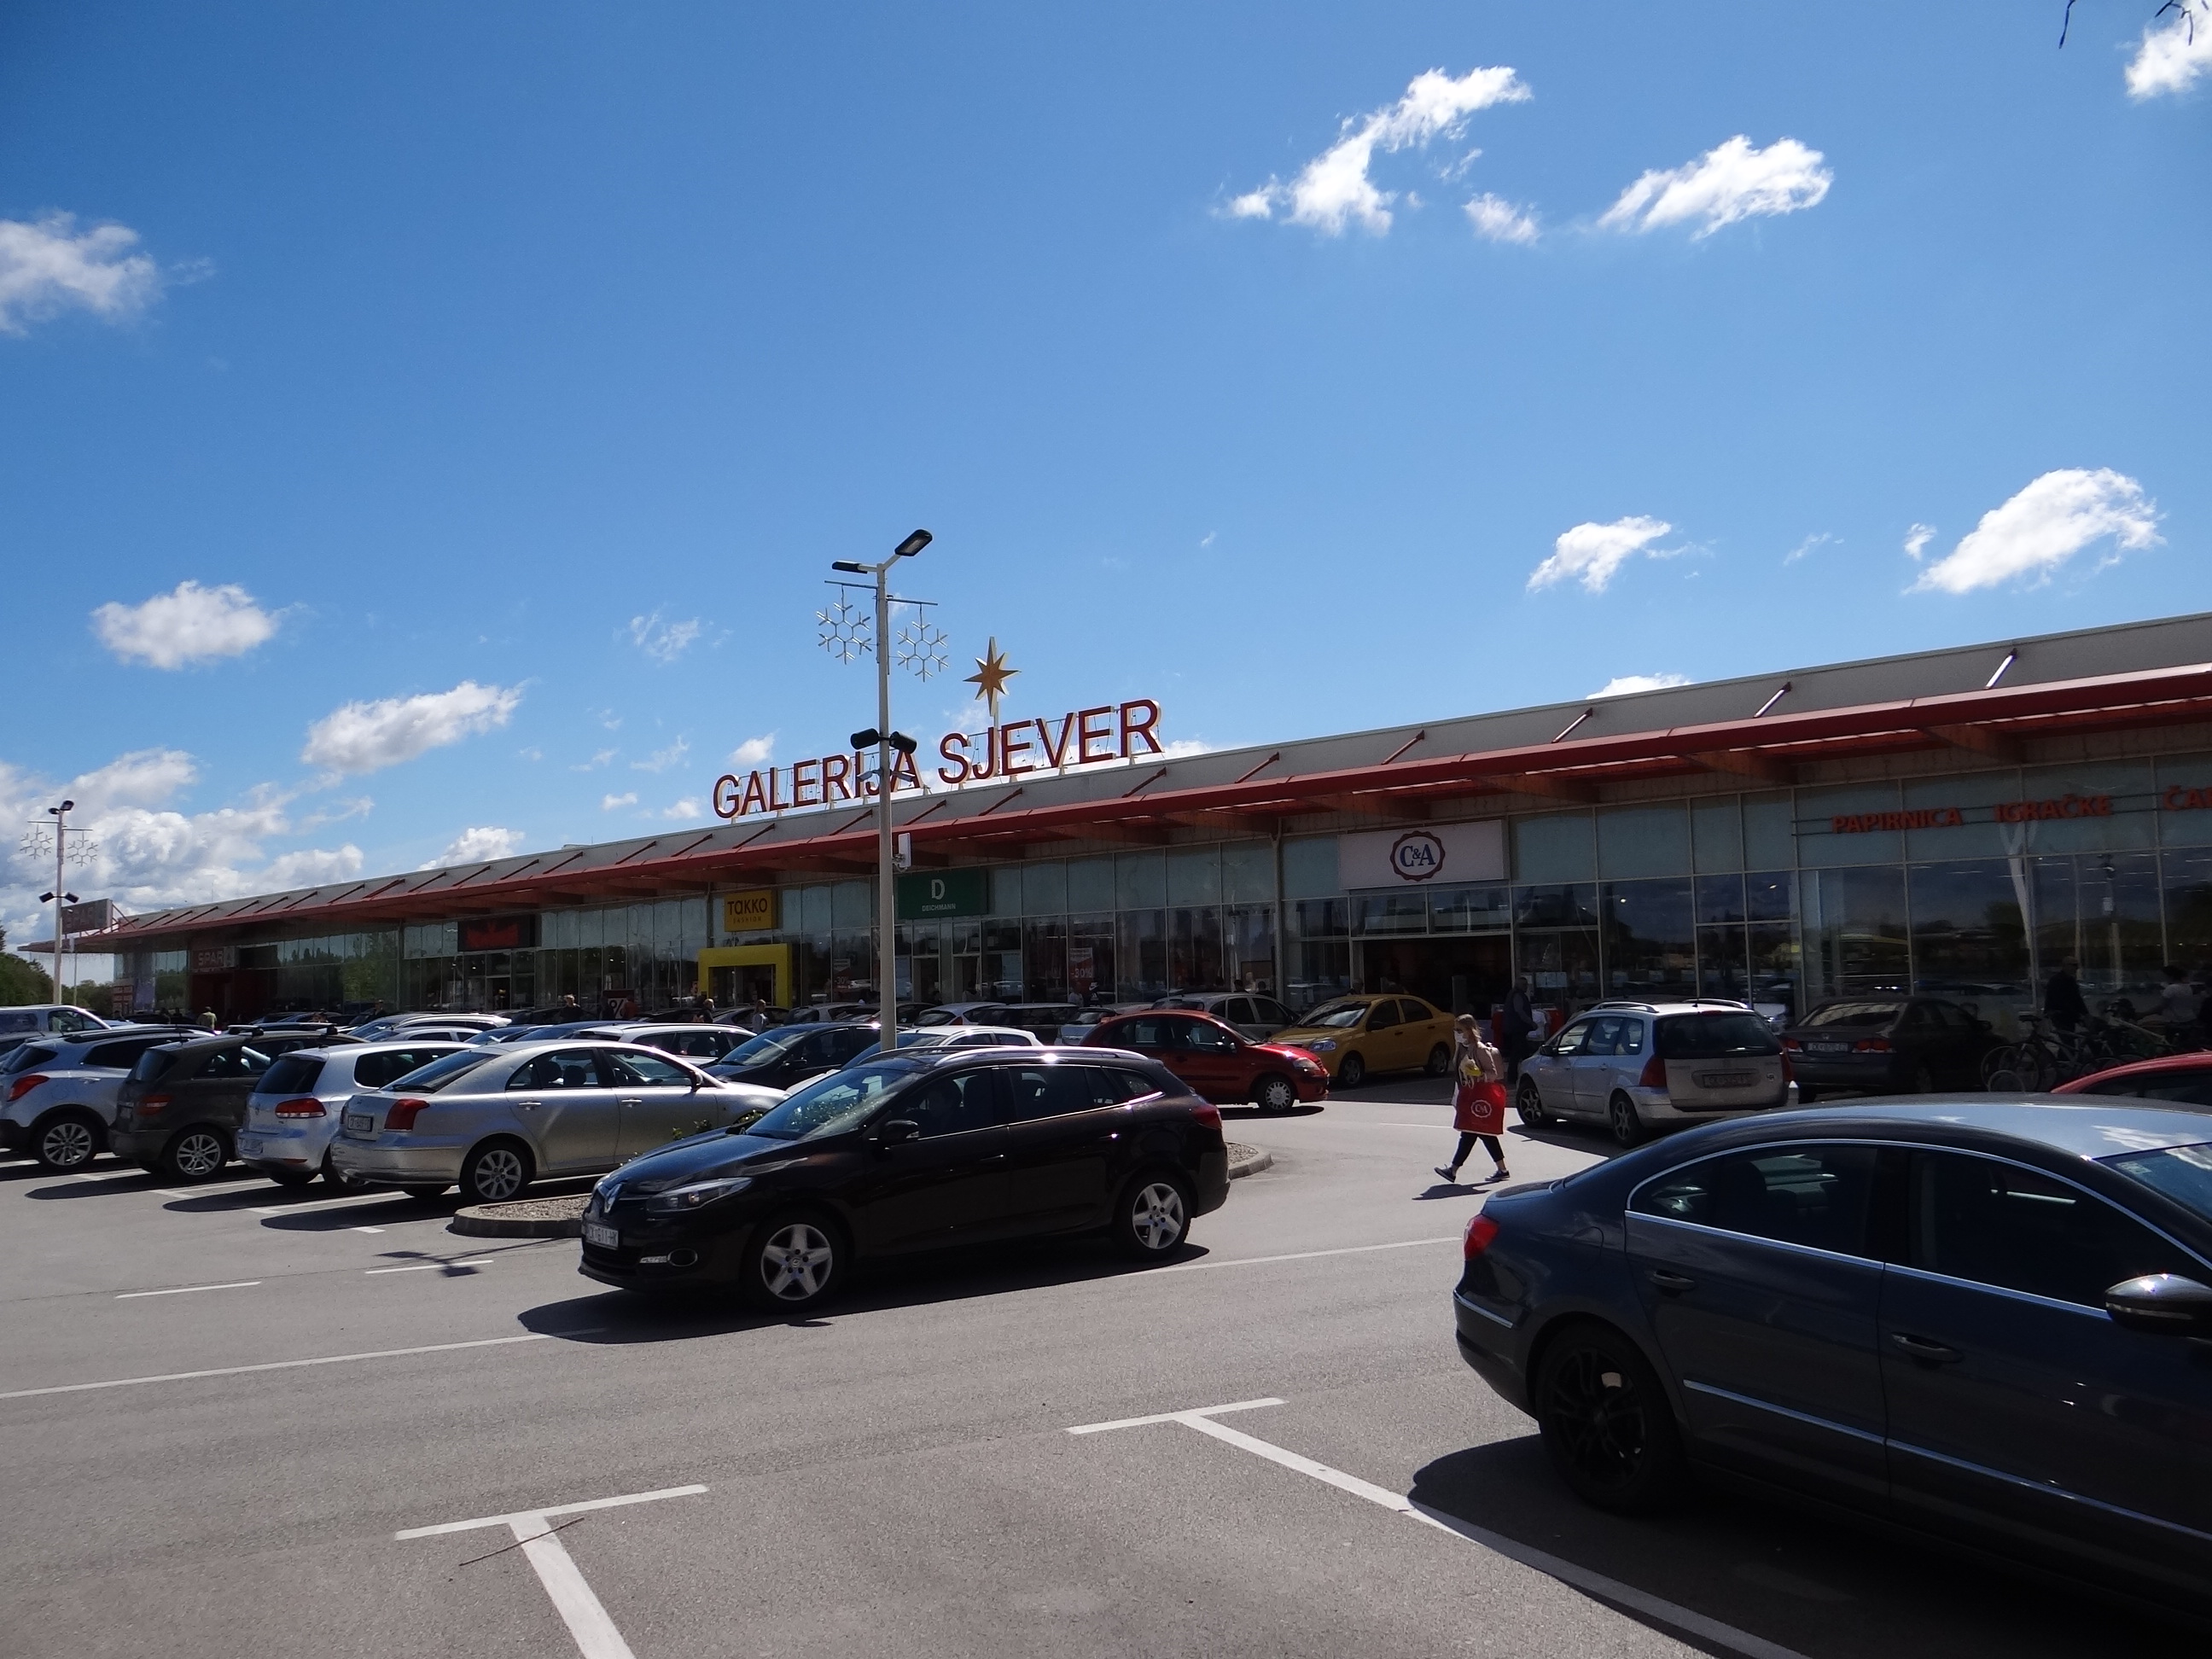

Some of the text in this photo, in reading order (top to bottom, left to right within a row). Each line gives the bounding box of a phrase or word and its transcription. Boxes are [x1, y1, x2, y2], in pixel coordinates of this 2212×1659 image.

[938, 699, 1163, 783] SJEVER
[1831, 807, 1963, 834] PAPIRNICA
[1994, 794, 2111, 823] IGRAČKE
[1400, 843, 1436, 867] C&A
[931, 879, 946, 900] D
[922, 903, 956, 911] DEICHMANN
[198, 951, 224, 966] SPAR
